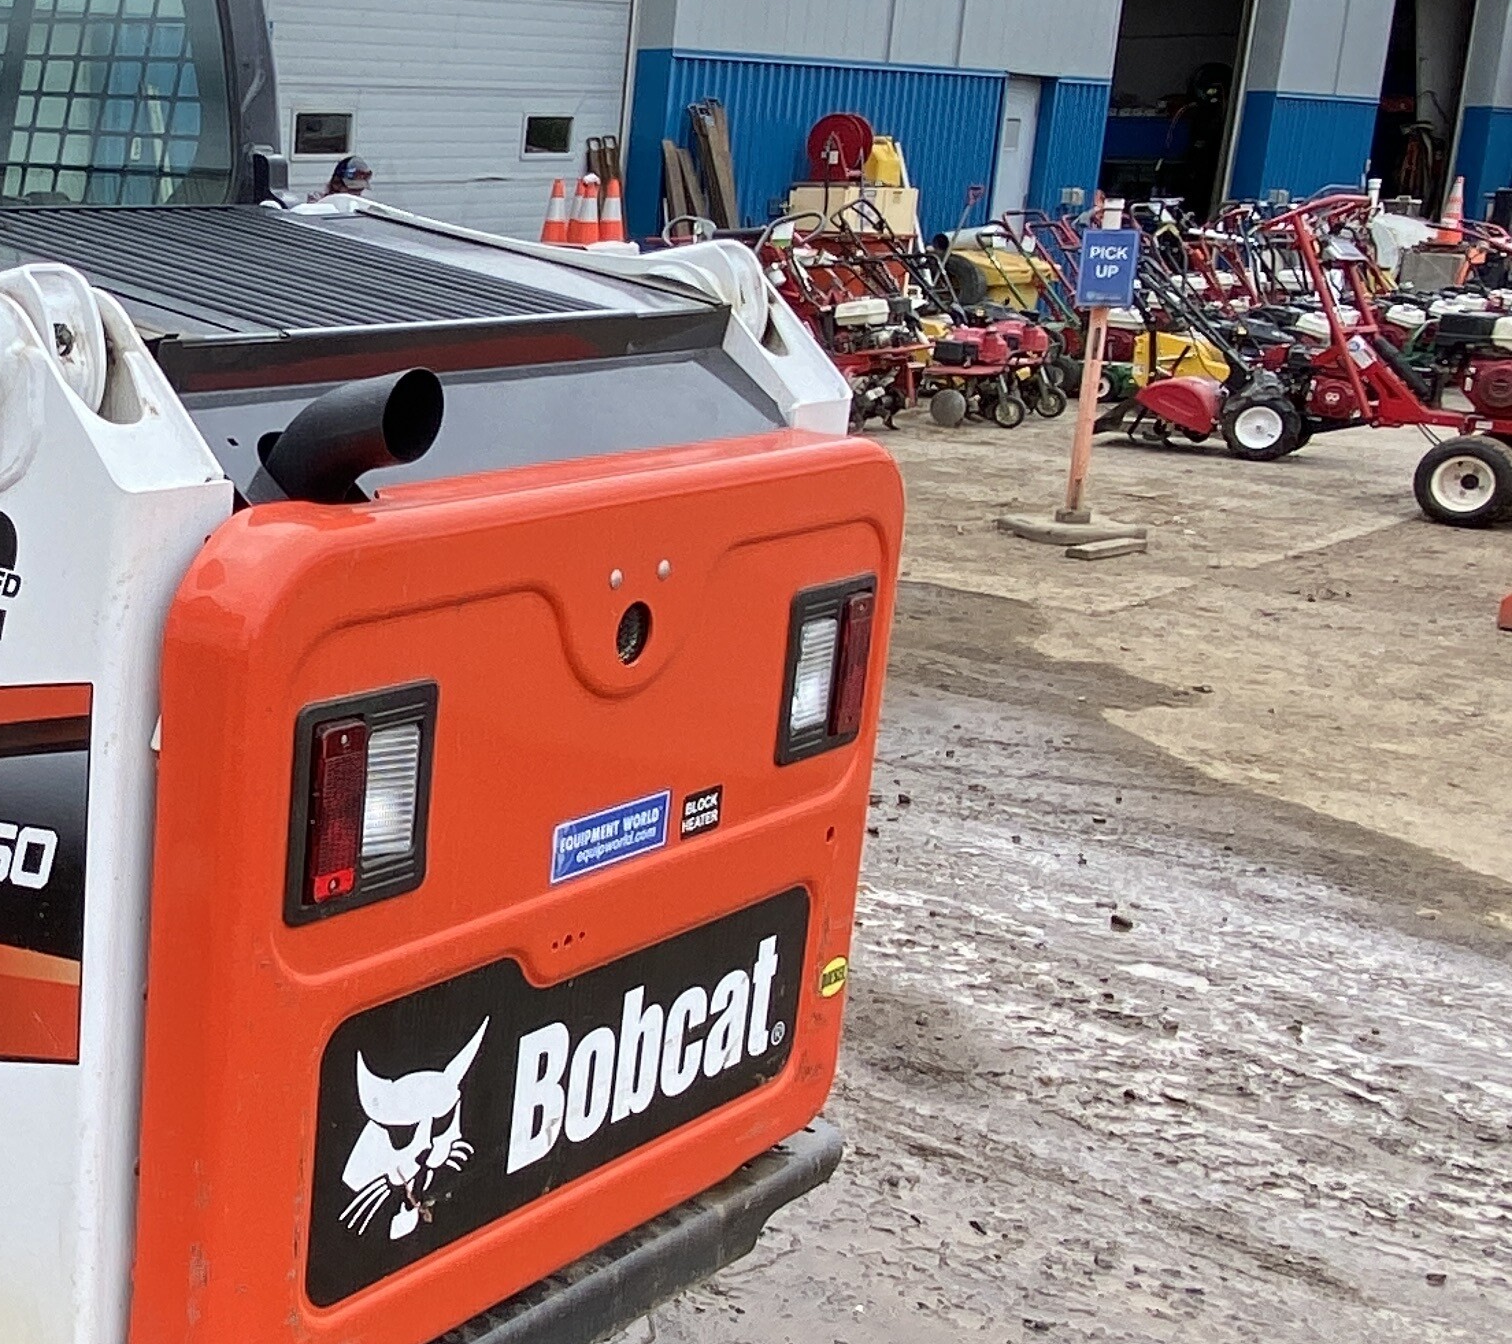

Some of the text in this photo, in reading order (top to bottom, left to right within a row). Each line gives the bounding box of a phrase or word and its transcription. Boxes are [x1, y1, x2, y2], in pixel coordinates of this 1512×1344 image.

[1089, 245, 1128, 261] PICK
[1095, 264, 1120, 278] UP
[685, 792, 718, 816] BLOCK
[559, 807, 660, 854] EQUIPMENT WORLD
[681, 809, 718, 834] HEATER
[506, 934, 779, 1175] Bobcat
